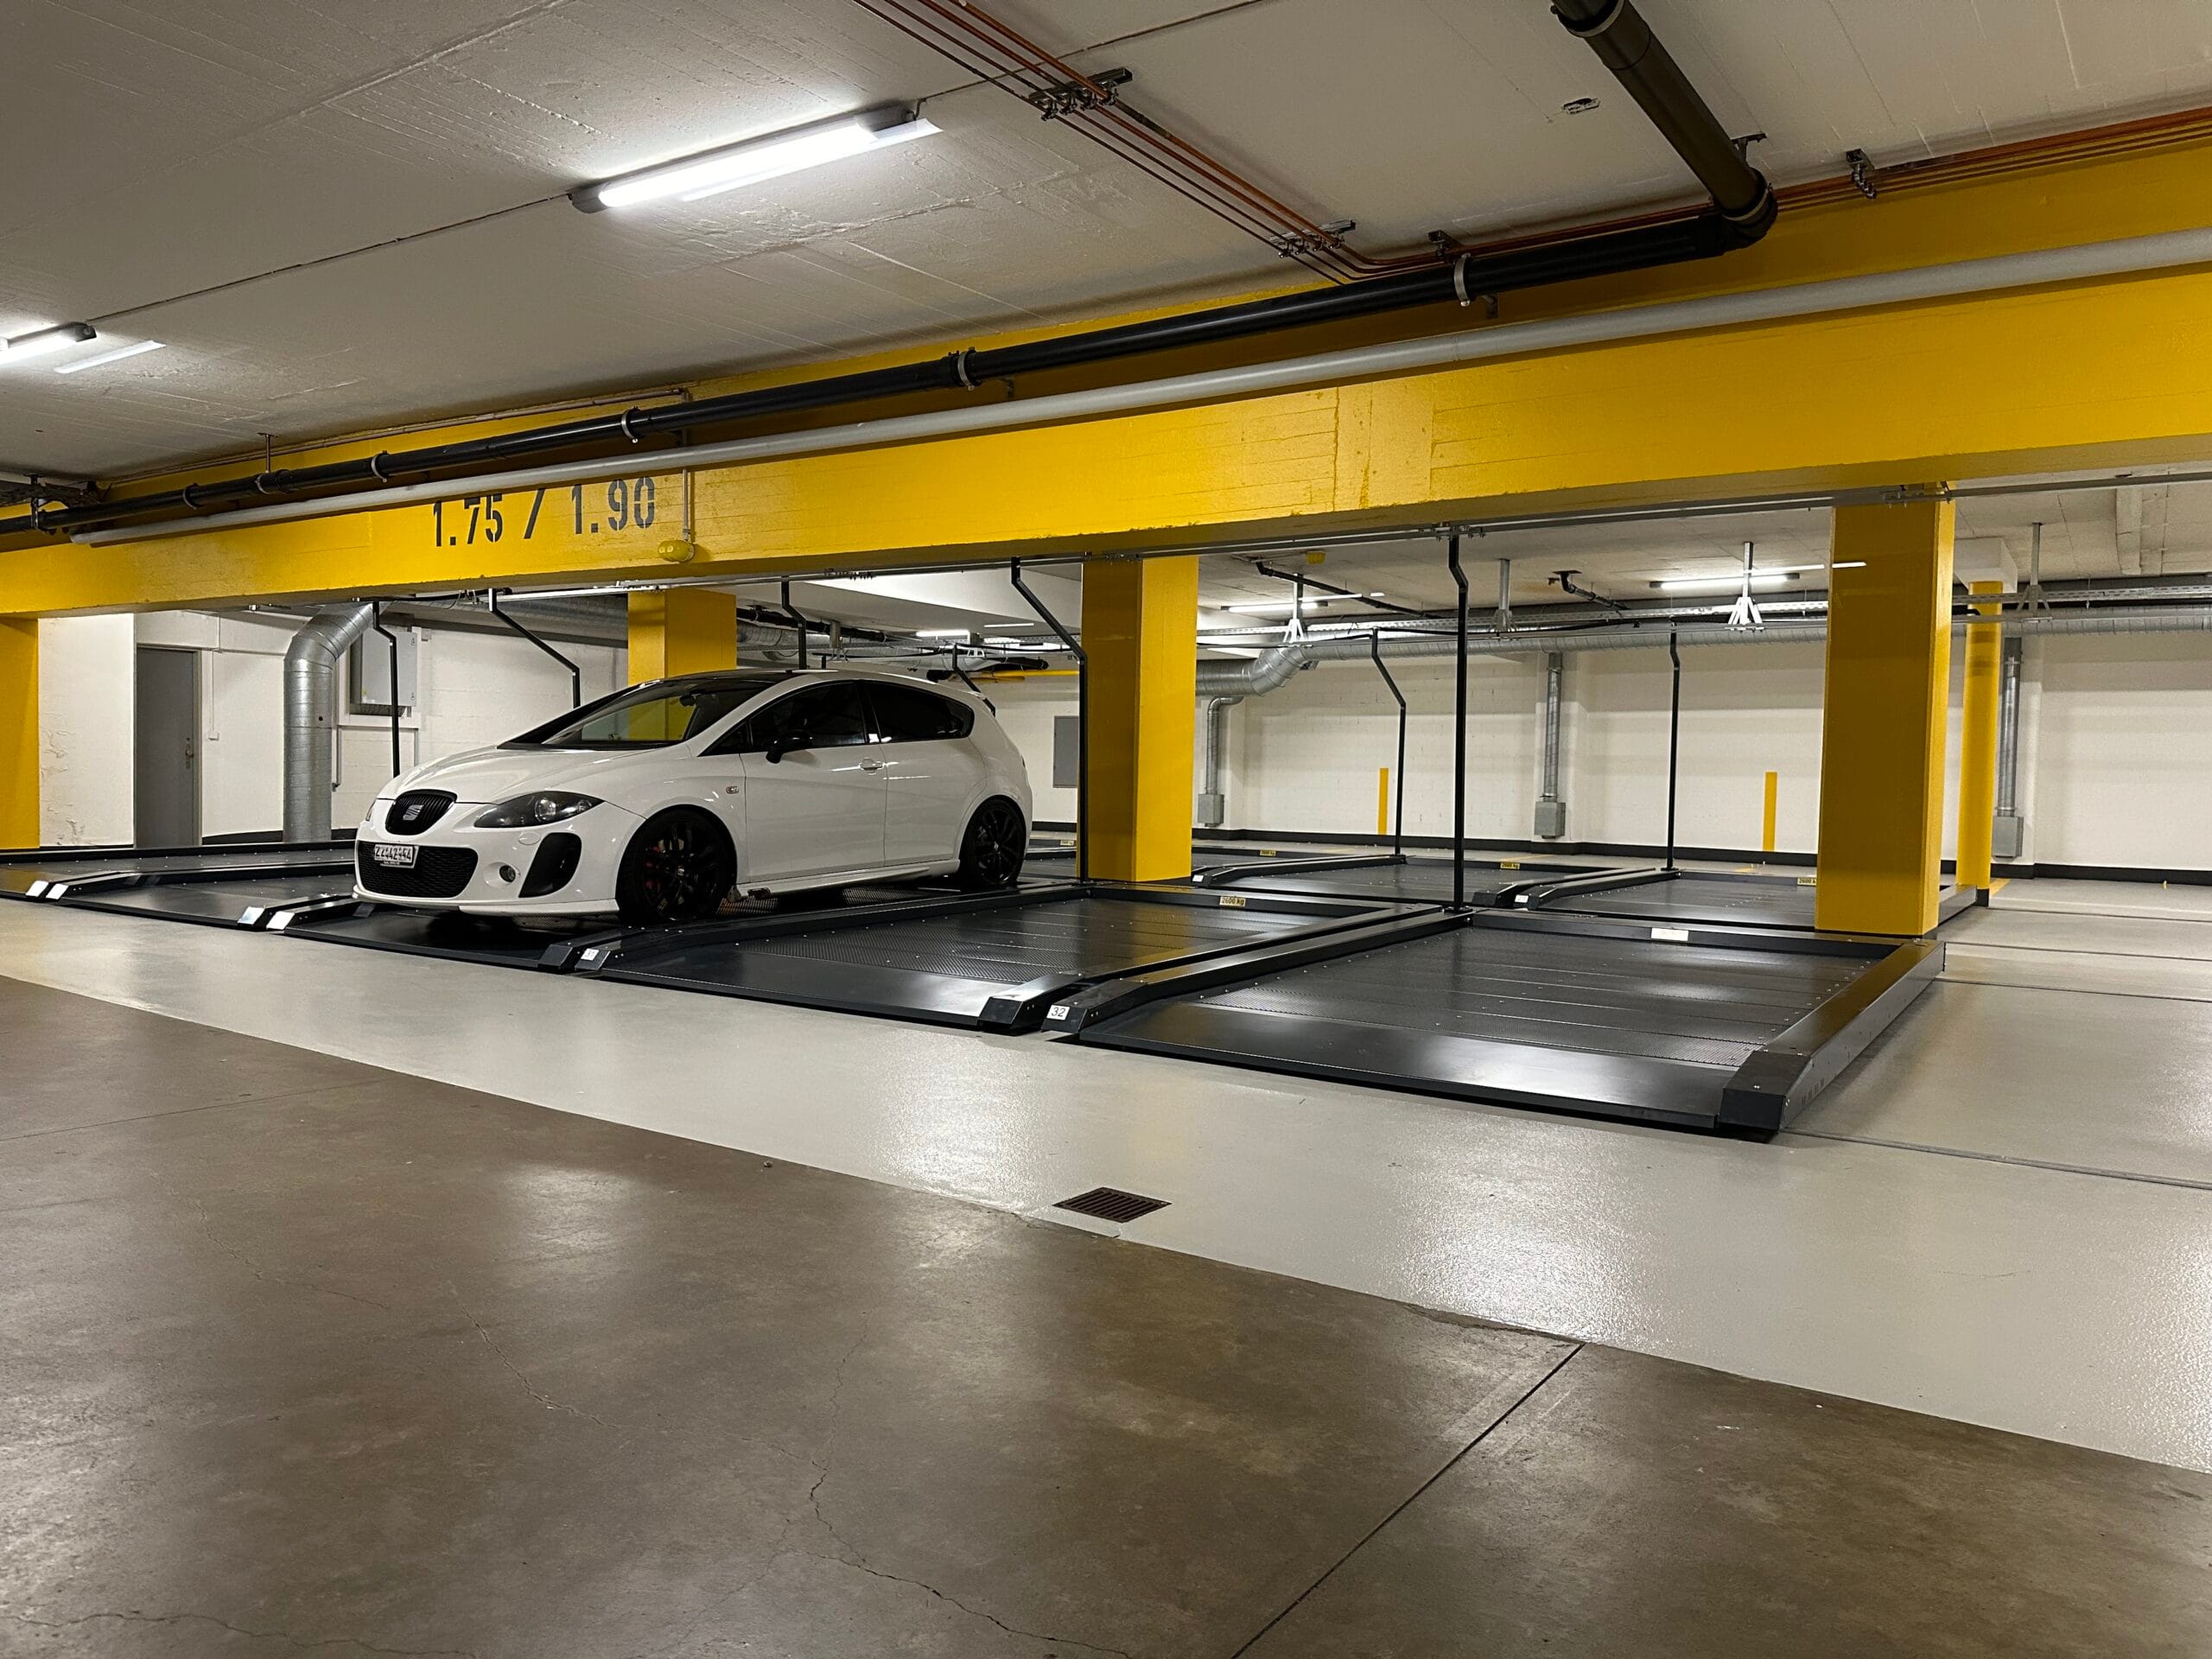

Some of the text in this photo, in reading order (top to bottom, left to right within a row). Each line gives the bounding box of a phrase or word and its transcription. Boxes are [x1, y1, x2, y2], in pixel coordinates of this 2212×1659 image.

[434, 477, 655, 547] 1.75 / 1.90
[1051, 1007, 1066, 1017] 32
